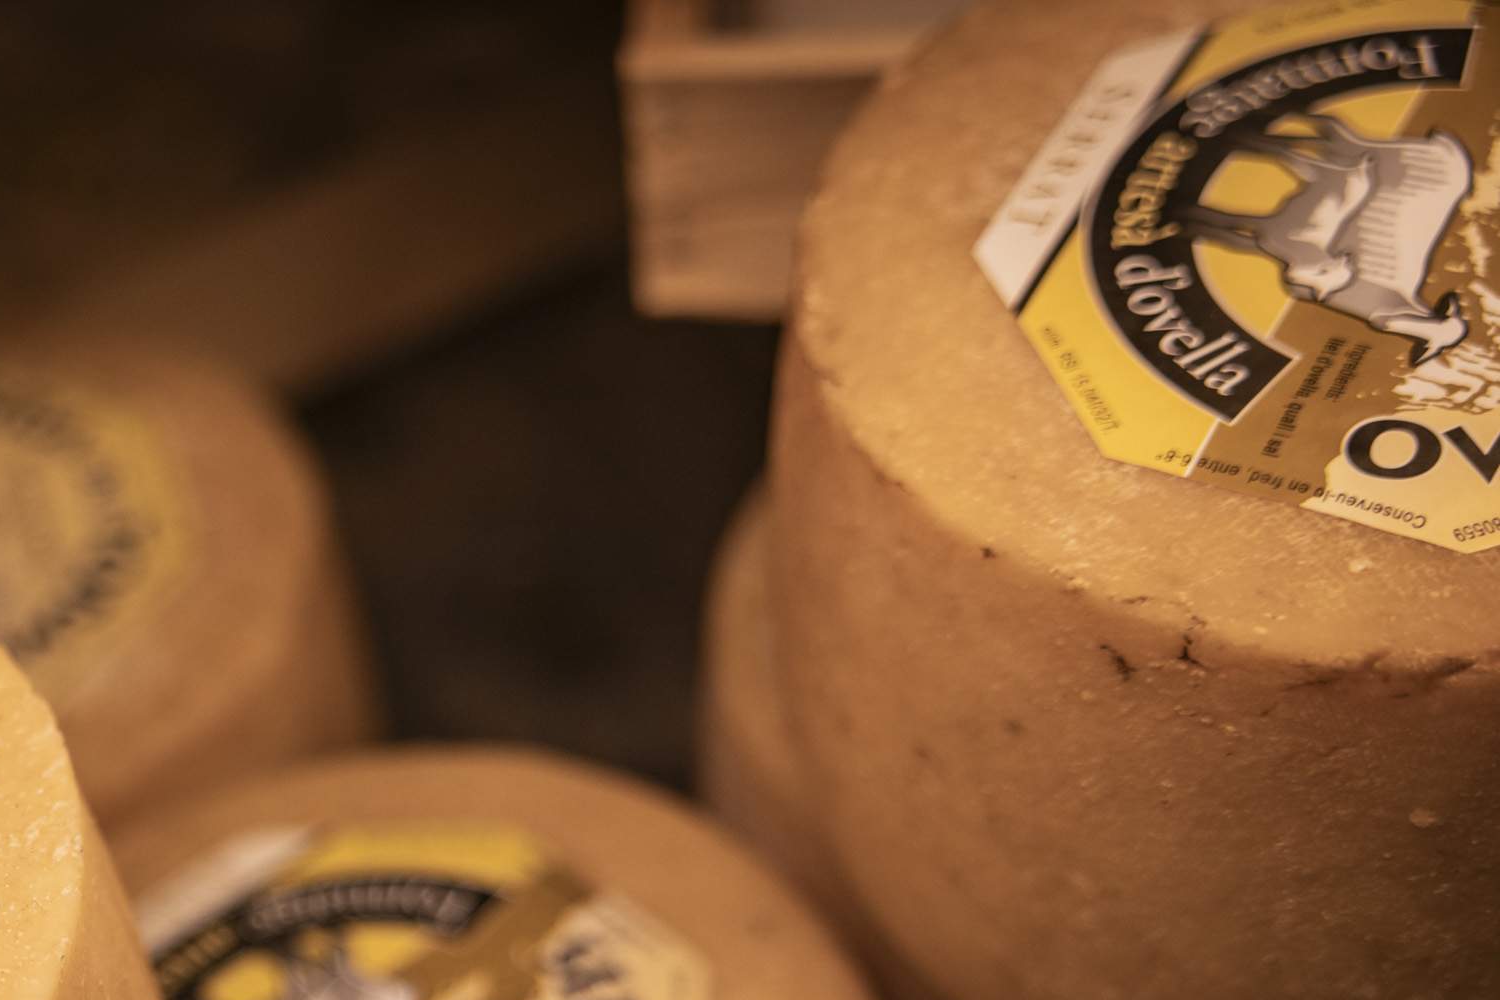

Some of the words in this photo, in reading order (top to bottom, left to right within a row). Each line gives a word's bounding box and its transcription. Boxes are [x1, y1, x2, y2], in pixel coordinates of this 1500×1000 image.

[1196, 456, 1241, 476] entre
[1246, 464, 1283, 490] fred,
[1286, 480, 1309, 494] en
[1312, 486, 1428, 529] Conserveu-lo
